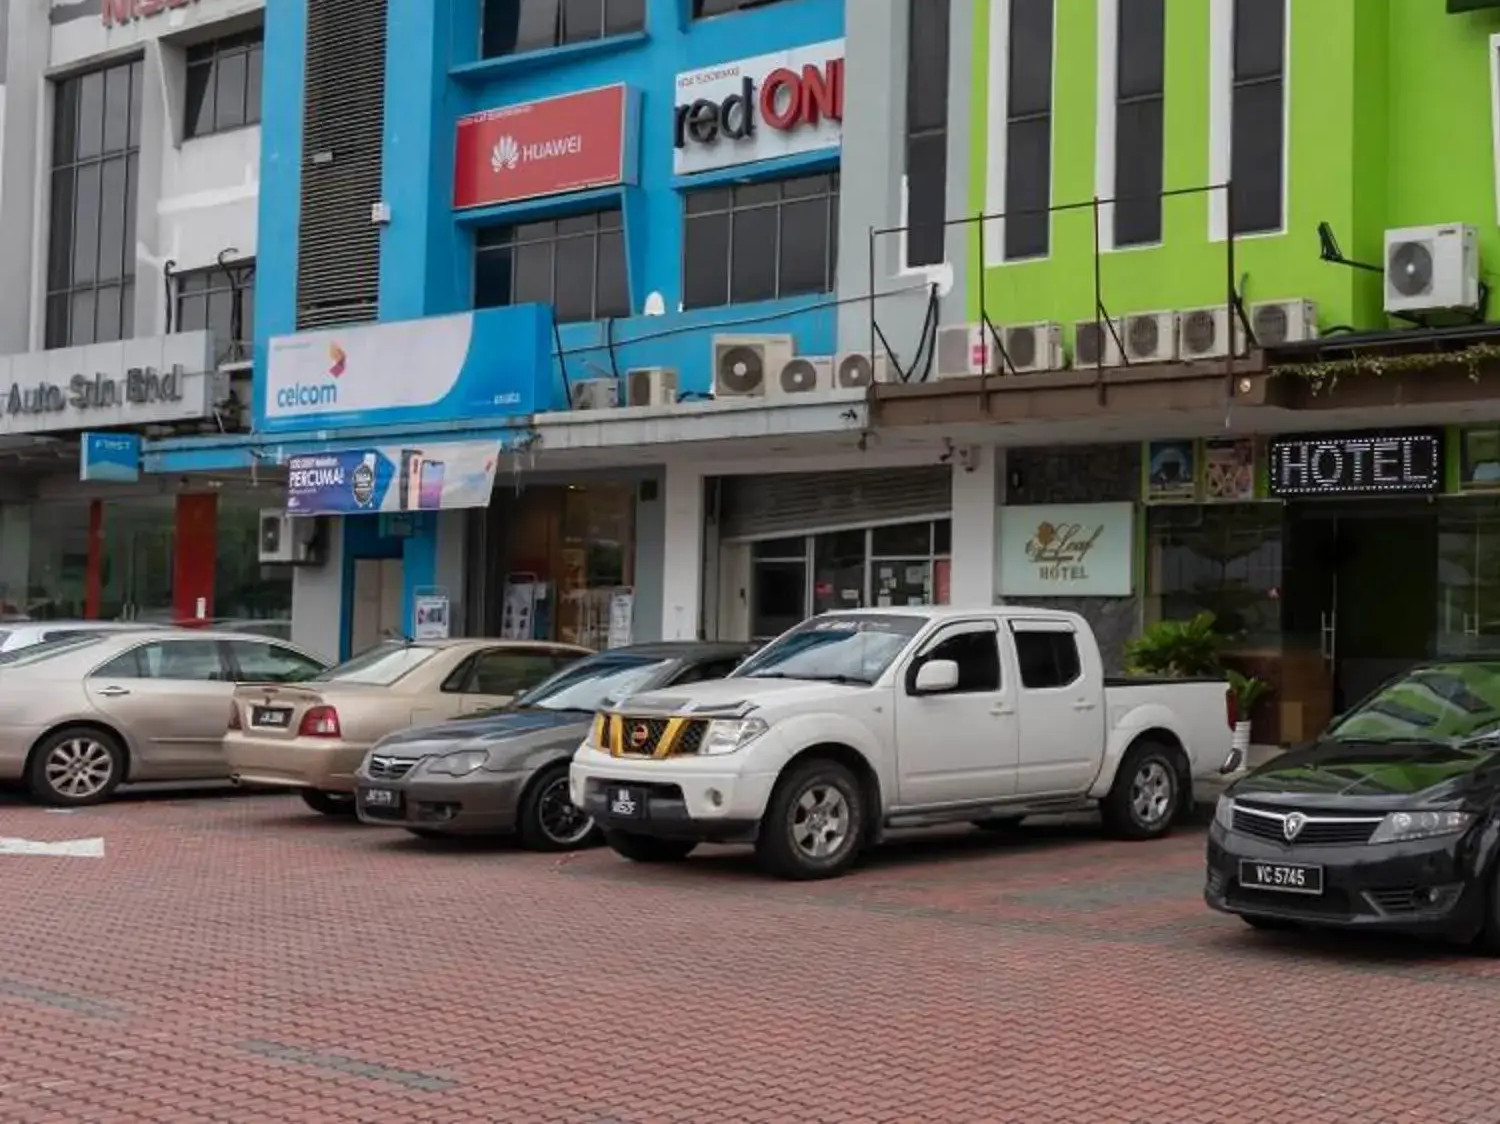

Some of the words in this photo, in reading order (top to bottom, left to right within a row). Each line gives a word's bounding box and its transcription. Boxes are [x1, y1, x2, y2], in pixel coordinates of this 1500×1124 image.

[521, 134, 583, 163] HUAWEI
[7, 381, 66, 417] Auto
[276, 381, 338, 408] celcom
[1282, 440, 1428, 487] HOTEL
[1038, 566, 1089, 580] HOTEL
[1274, 867, 1305, 886] 5745
